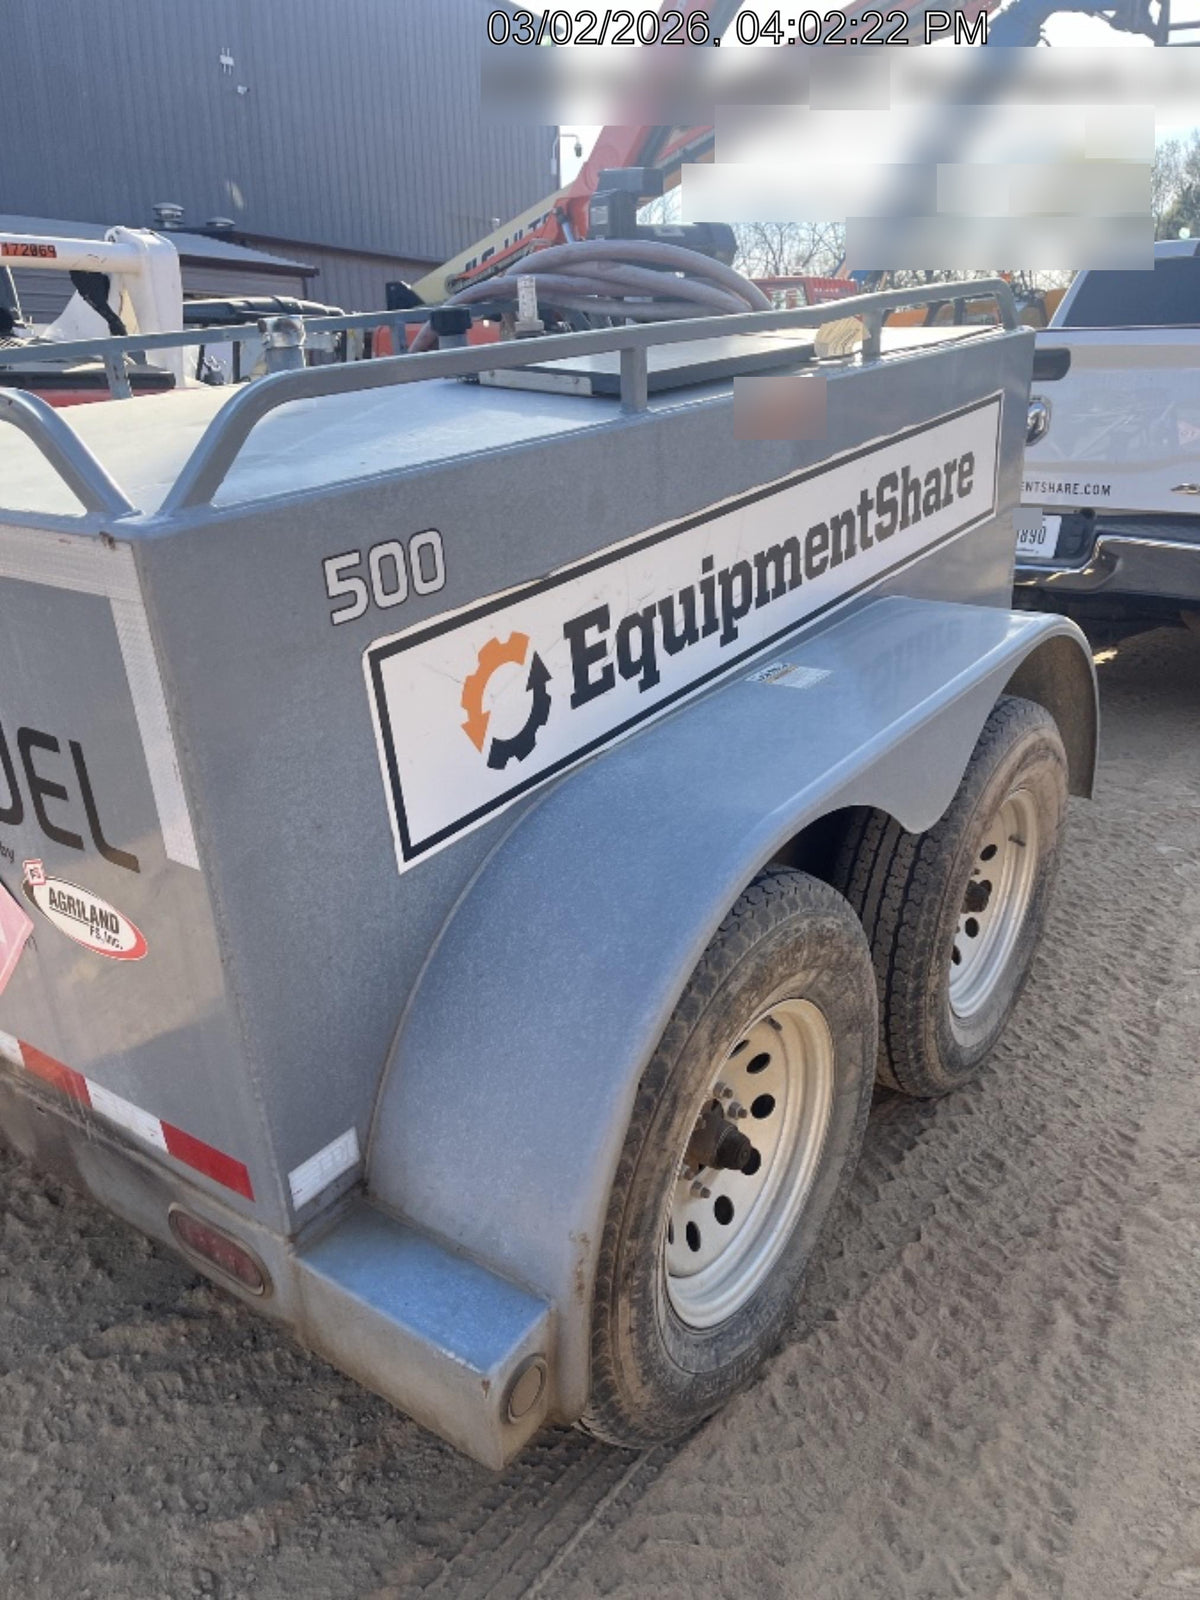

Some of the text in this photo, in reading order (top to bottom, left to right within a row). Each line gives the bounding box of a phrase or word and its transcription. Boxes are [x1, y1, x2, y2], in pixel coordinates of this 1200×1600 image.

[321, 527, 447, 626] 500
[562, 450, 976, 711] EquipmentShare
[48, 886, 120, 934] AGRILAND
